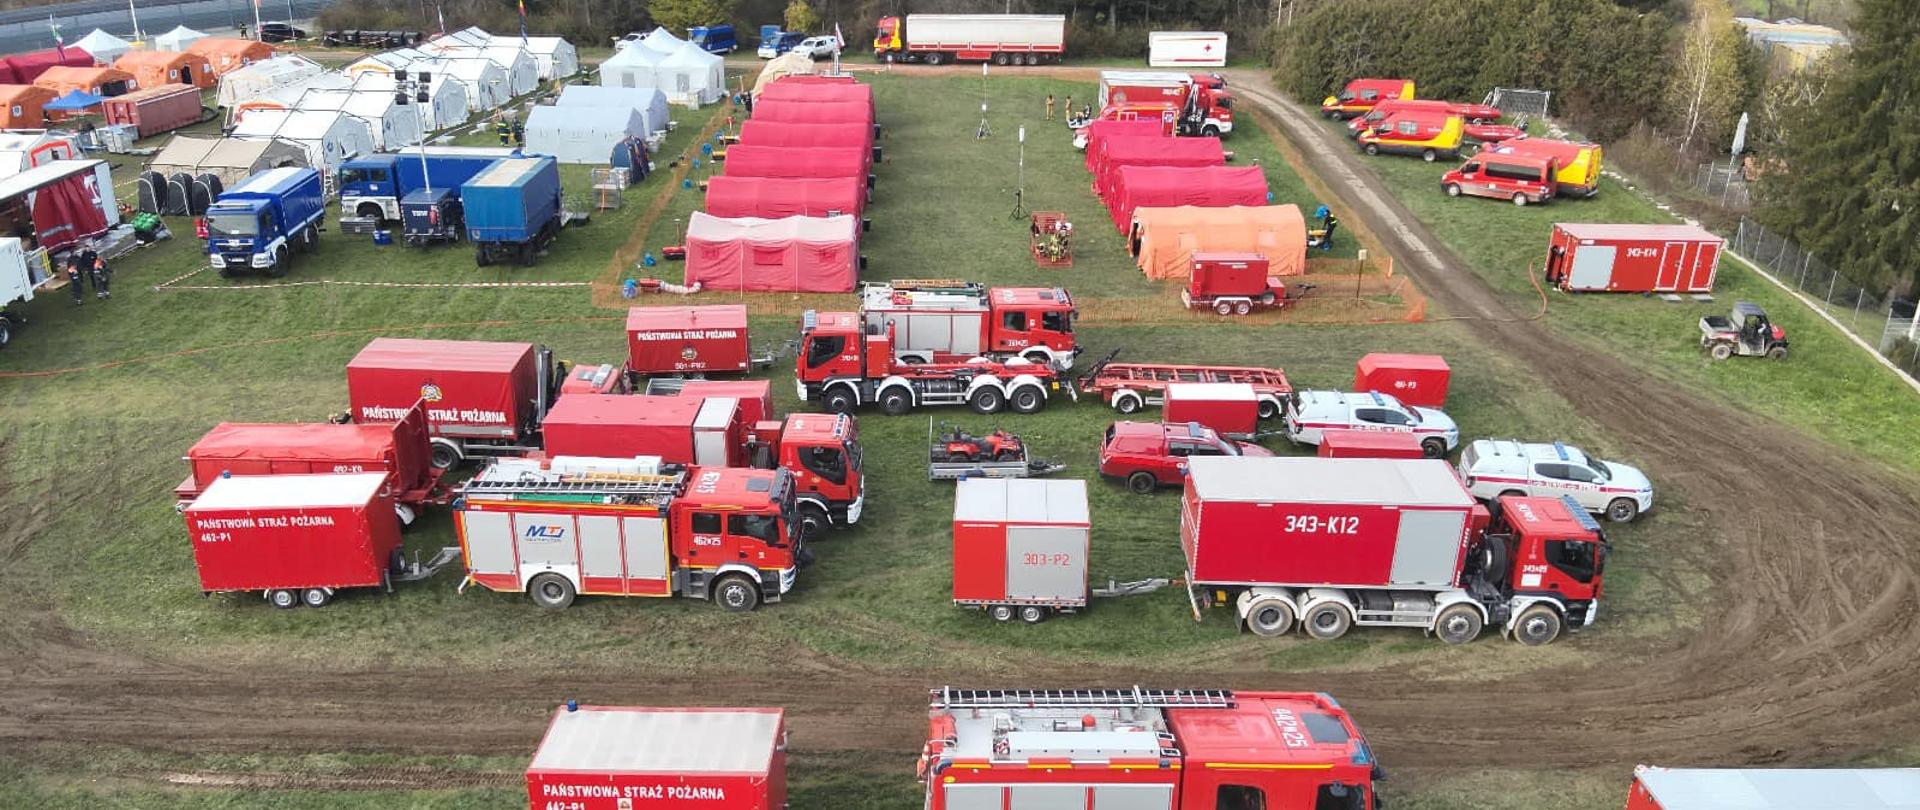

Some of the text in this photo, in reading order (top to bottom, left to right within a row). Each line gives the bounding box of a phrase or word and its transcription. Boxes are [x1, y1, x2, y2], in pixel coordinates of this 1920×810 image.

[683, 330, 706, 340] STRAŻ
[428, 407, 459, 421] STRAŻ
[461, 408, 506, 422] POŻARNA
[197, 515, 335, 529] PAŃSTWOWA STRAŻ POŻARNA
[1284, 515, 1360, 534] 343-K12
[201, 532, 232, 542] 462-P1
[1023, 552, 1072, 566] 303-P2
[543, 783, 726, 801] PAŃSTWOWA STRAŻ POŻARNA
